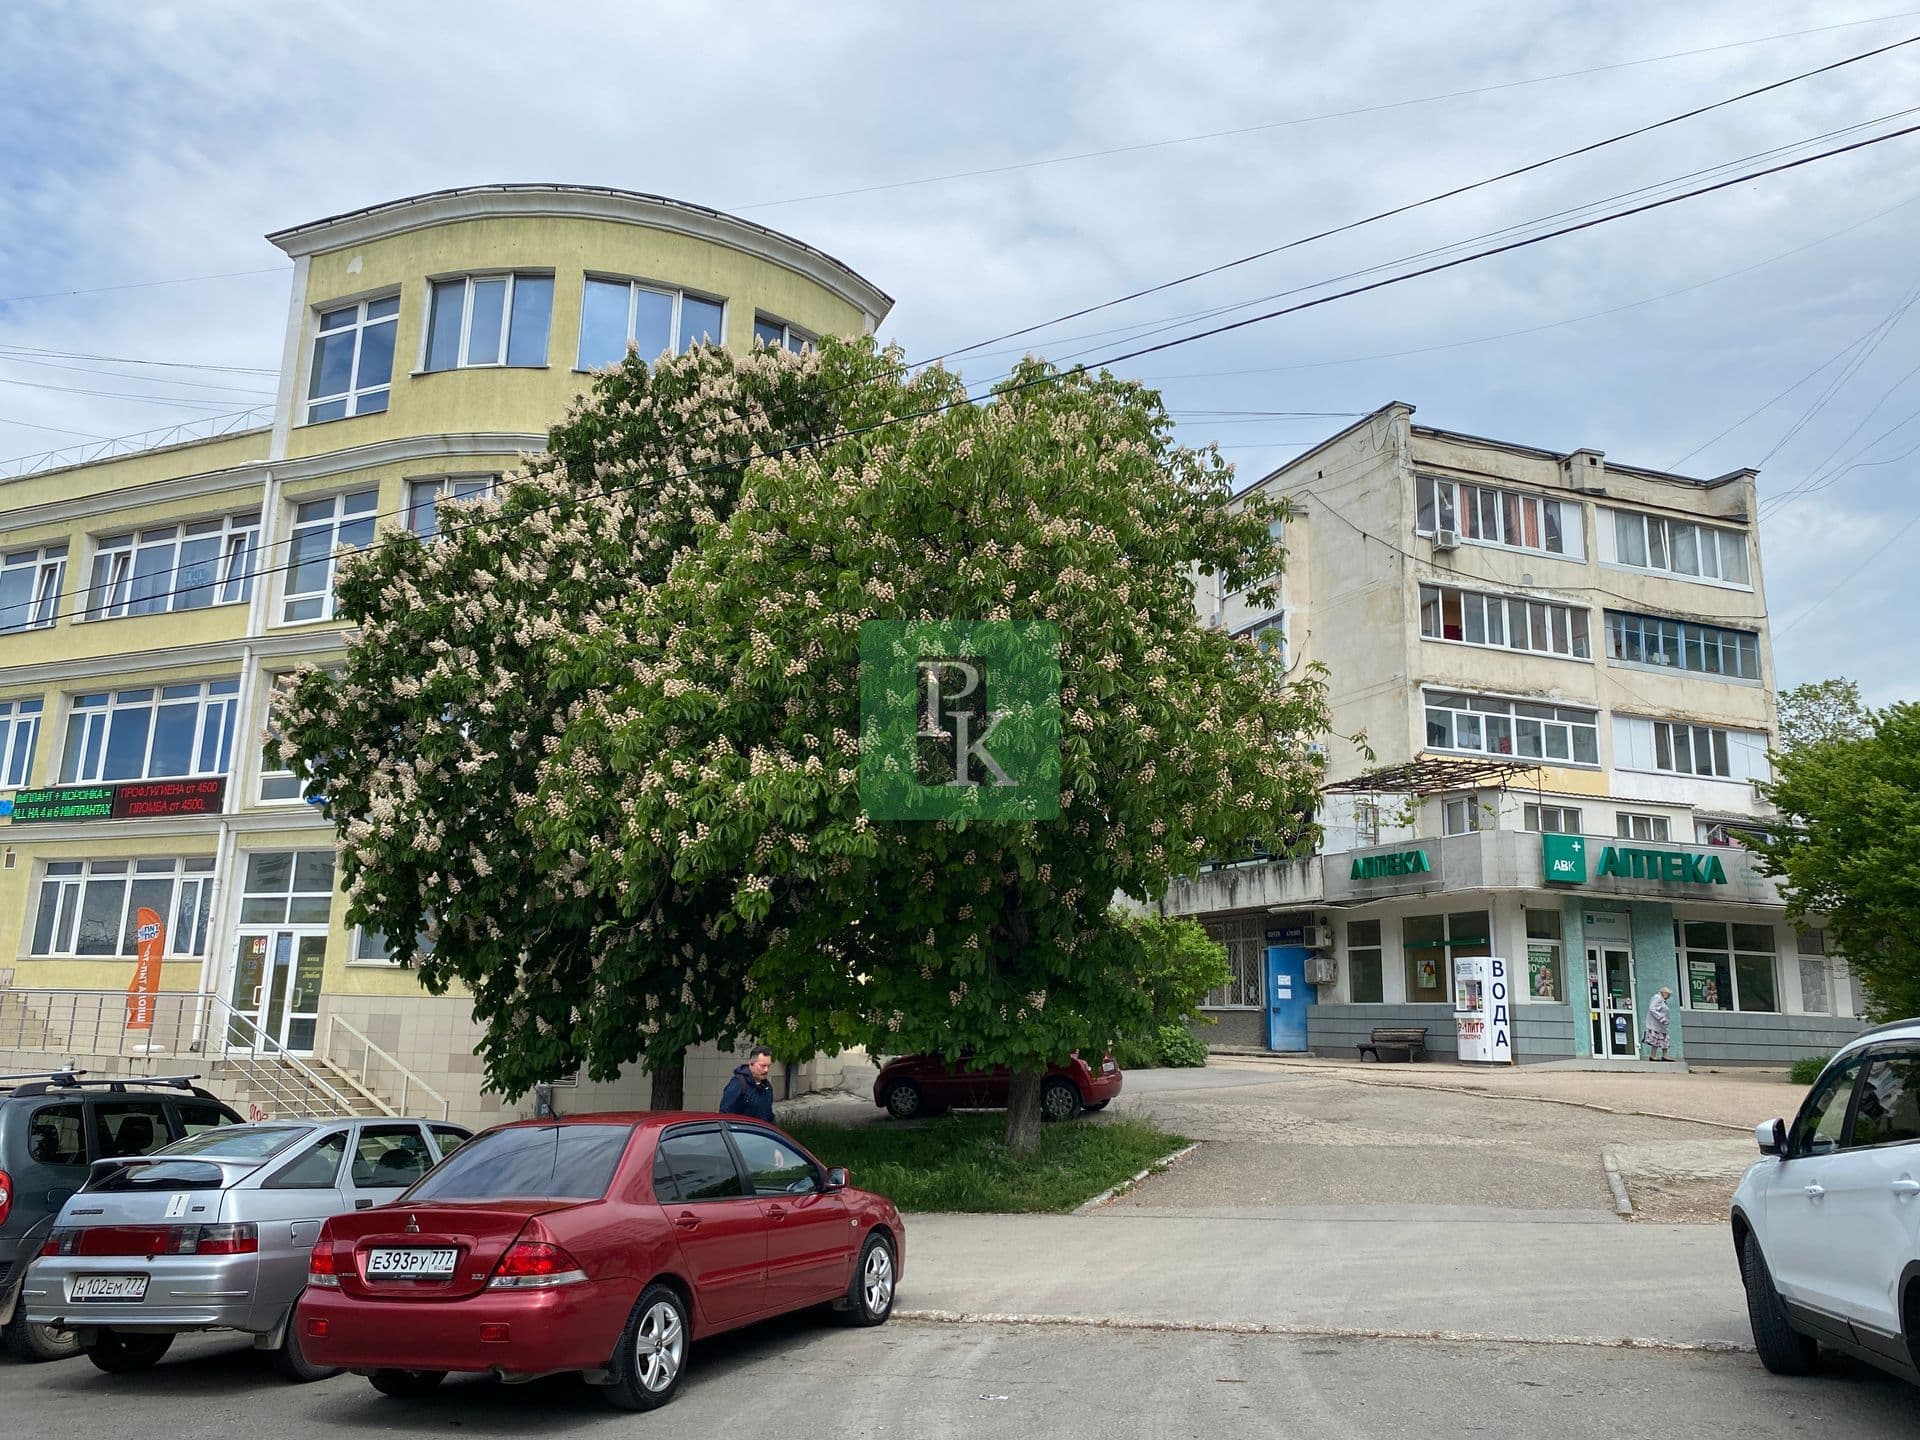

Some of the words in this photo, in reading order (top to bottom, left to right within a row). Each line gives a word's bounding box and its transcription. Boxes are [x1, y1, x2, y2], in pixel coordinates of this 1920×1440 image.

[197, 781, 218, 793] 4500
[28, 807, 39, 818] НА
[129, 800, 168, 814] ПЛОМБА
[1350, 849, 1431, 880] АПТЕКА
[1553, 859, 1576, 872] АВК
[1597, 846, 1728, 885] АПТЕКА
[1492, 960, 1509, 1047] ВОДА
[372, 1252, 429, 1270] Е393РУ
[431, 1251, 453, 1265] 777
[76, 1279, 123, 1295] Н102ЕМ
[124, 1277, 145, 1291] 777
